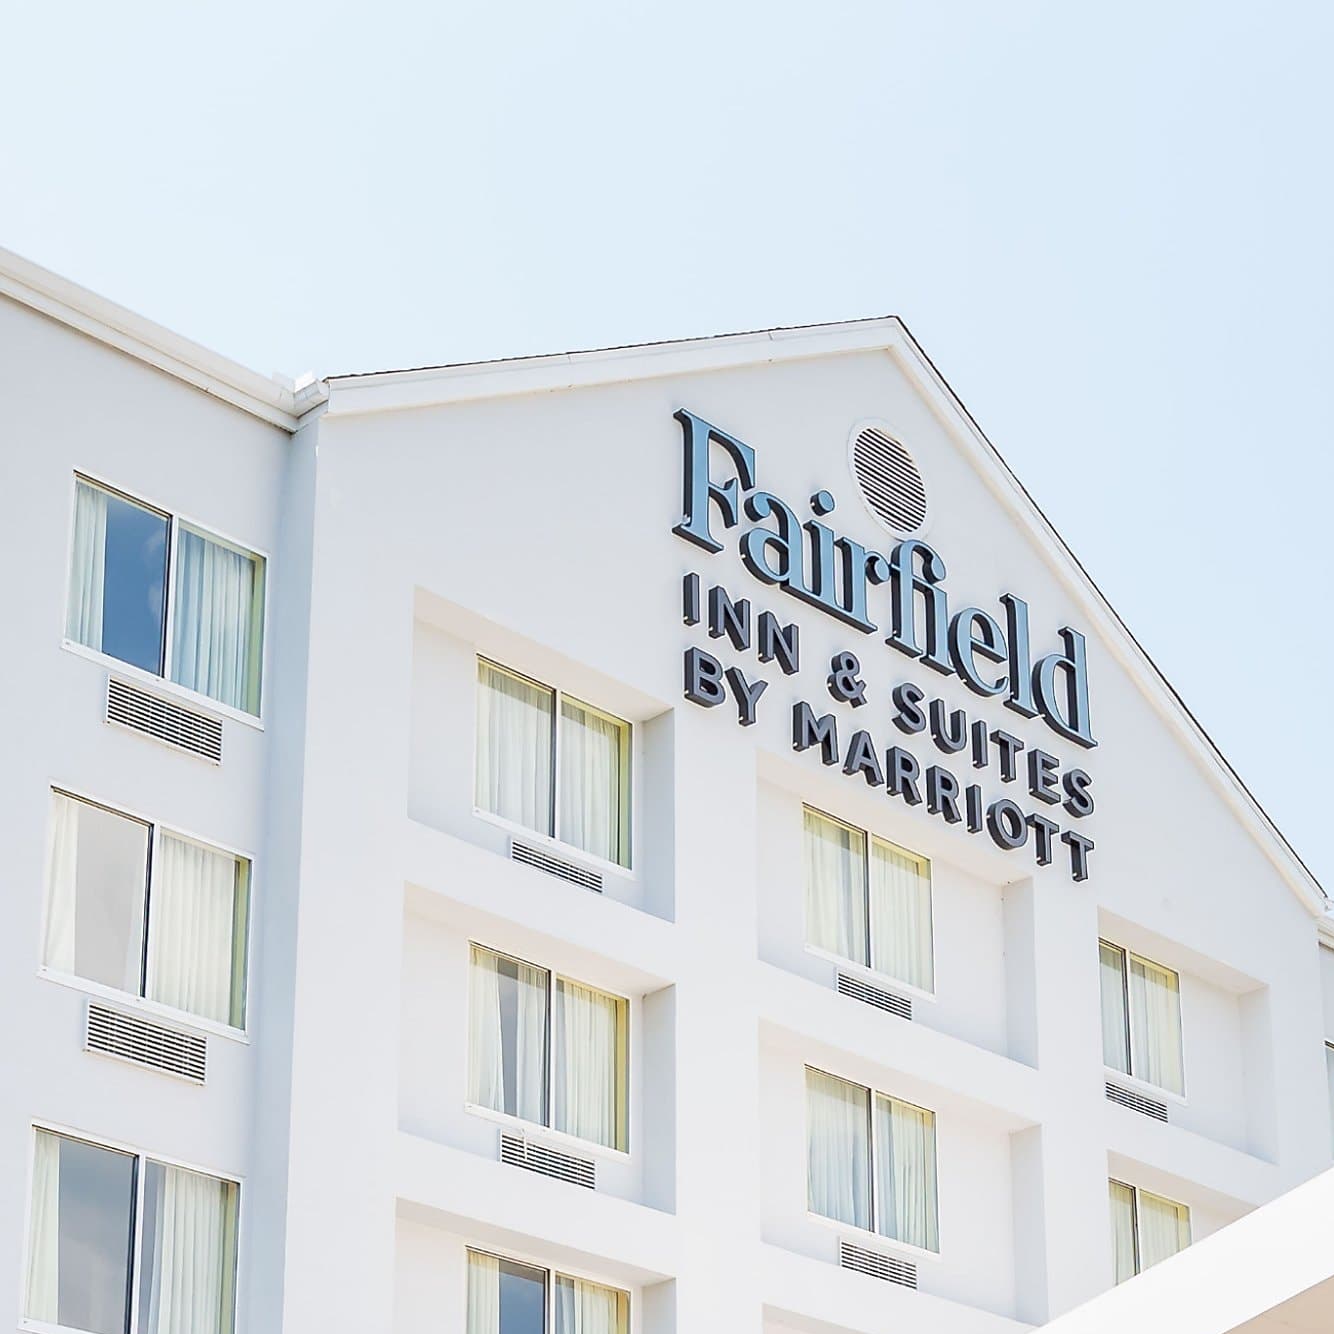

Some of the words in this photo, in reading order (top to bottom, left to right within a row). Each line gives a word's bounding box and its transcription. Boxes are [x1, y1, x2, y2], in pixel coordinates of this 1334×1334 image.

[673, 408, 1098, 748] Fairfield
[683, 572, 799, 674] INN
[827, 651, 866, 708] &
[892, 682, 1094, 818] SUITES
[684, 646, 768, 726] BY
[793, 701, 1094, 882] MARRIOTT
